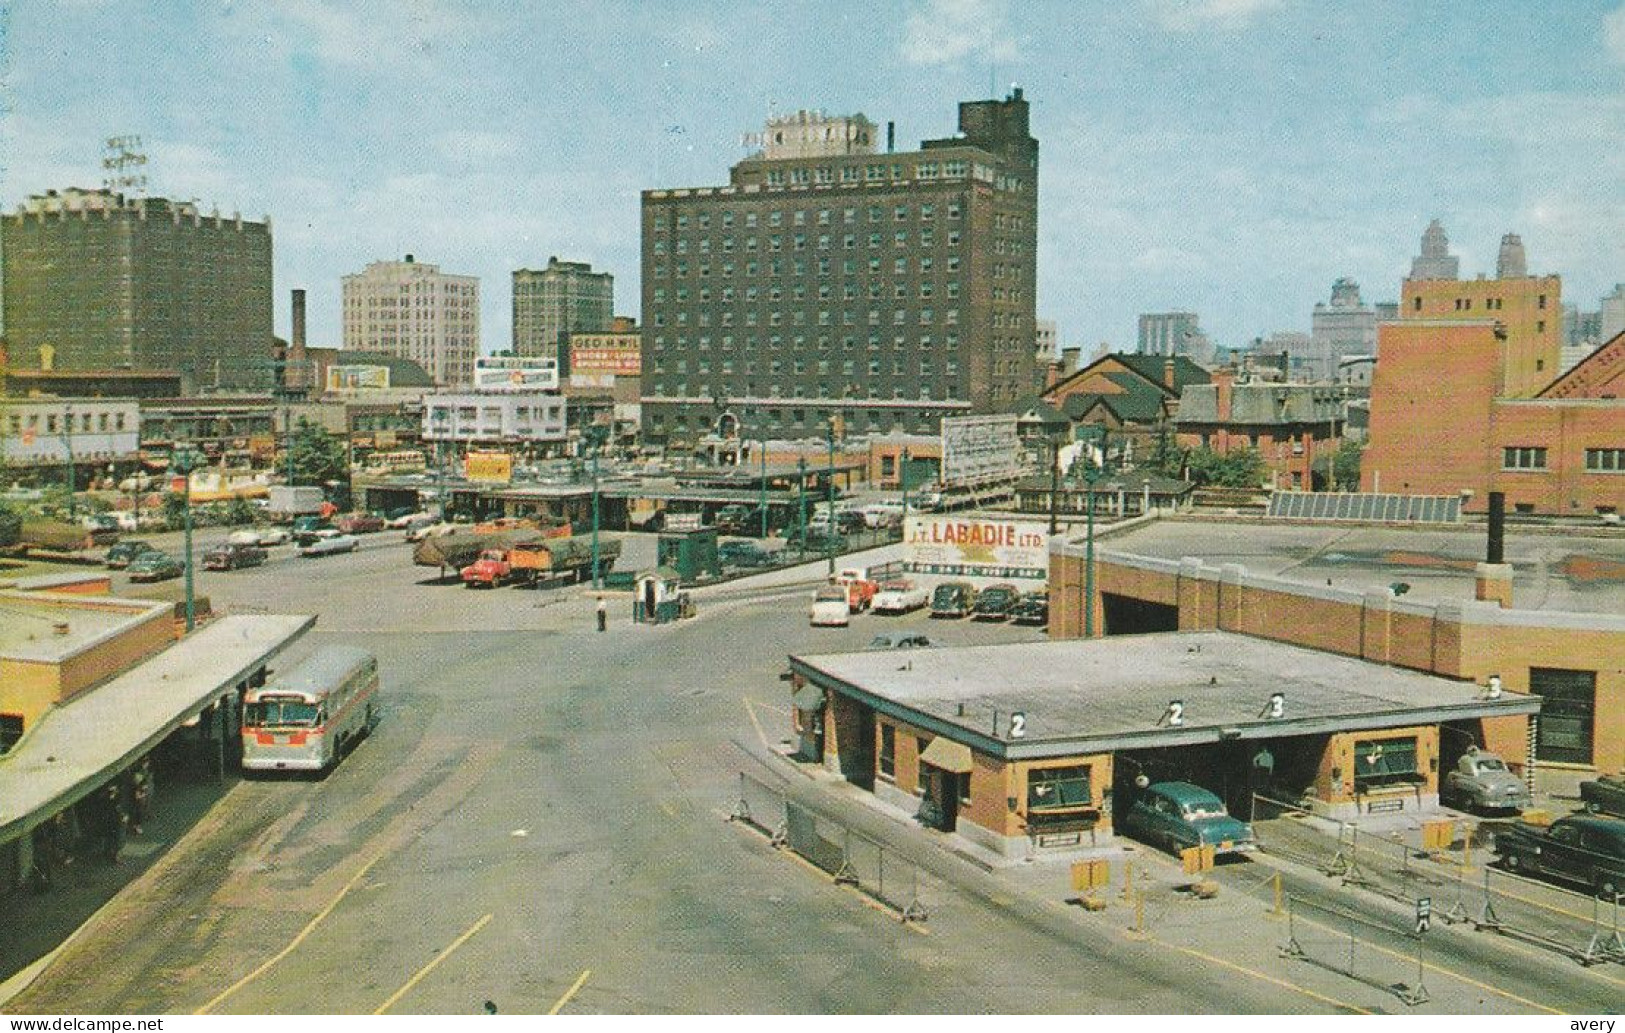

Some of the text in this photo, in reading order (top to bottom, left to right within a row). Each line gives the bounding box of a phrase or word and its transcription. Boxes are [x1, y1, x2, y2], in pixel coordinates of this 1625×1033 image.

[932, 522, 1015, 546] LABADIE
[1019, 533, 1045, 547] LTD.
[1490, 678, 1501, 698] 3
[1170, 702, 1183, 725] 2
[1272, 696, 1284, 718] 3
[1011, 714, 1025, 736] 2
